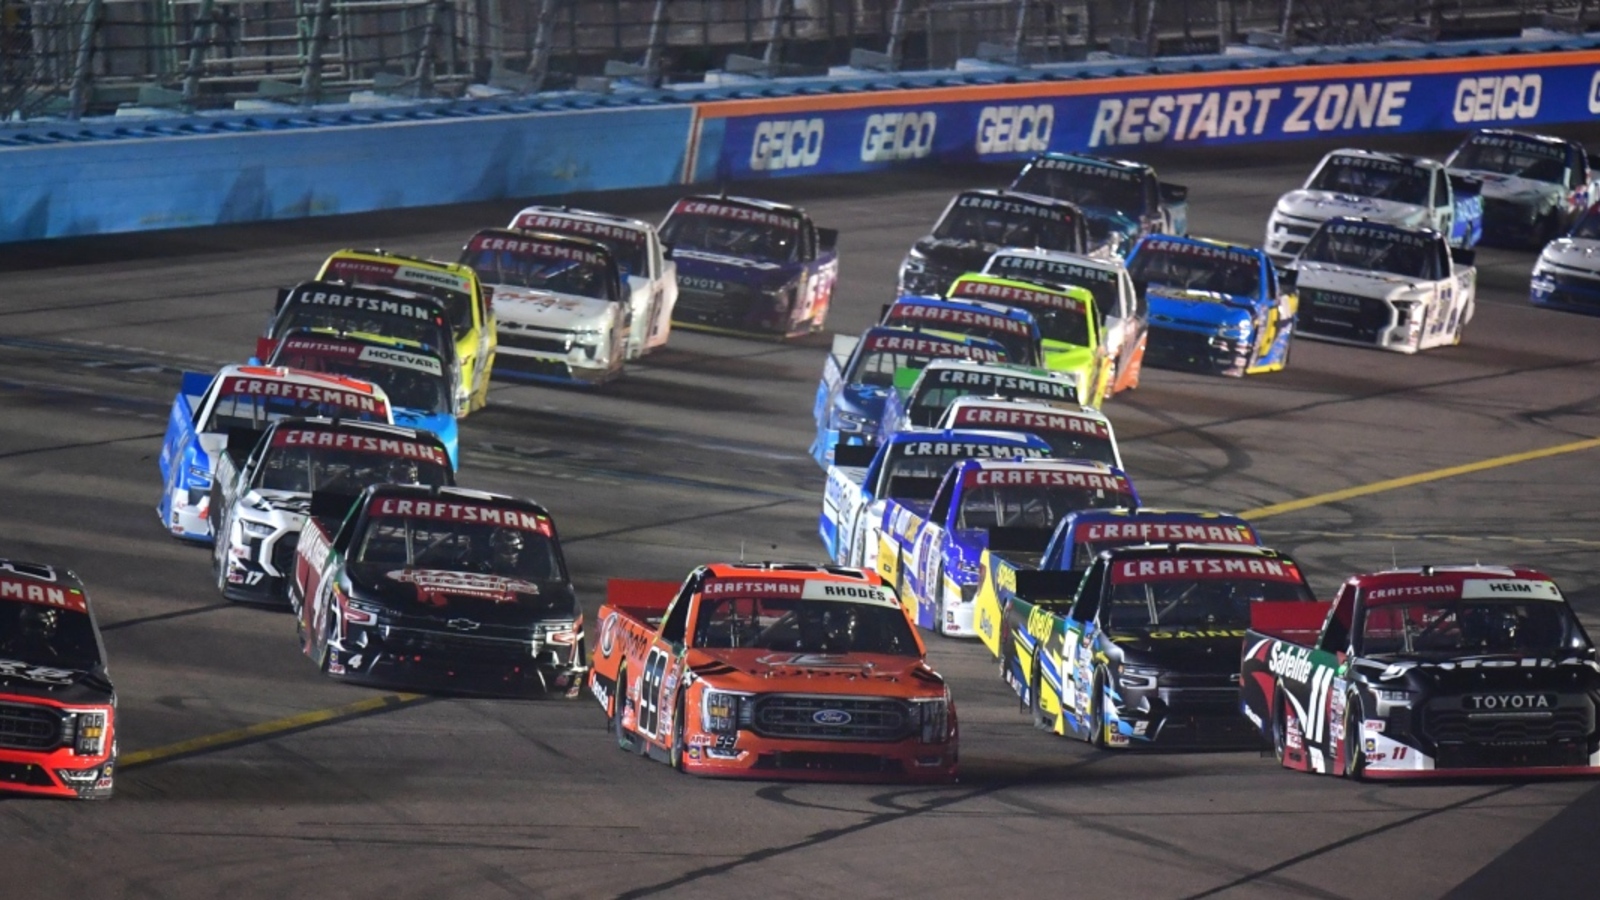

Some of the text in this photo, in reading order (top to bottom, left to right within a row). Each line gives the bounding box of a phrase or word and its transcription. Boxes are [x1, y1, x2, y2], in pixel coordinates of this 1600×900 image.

[1453, 74, 1542, 124] GEICO
[1088, 80, 1412, 149] RESTART ZONE
[861, 111, 938, 163] GEICO
[975, 105, 1055, 154] GEICO
[750, 118, 825, 171] GEICO
[684, 202, 792, 228] CRAFTSMAN
[959, 196, 1062, 221] CRAFTSMAN
[524, 214, 638, 242] CRAFTSMAN
[480, 237, 601, 263] CRAFTSMAN
[404, 270, 460, 288] ENFINGER
[1000, 256, 1112, 283] CRAFTSMAN
[300, 291, 430, 320] CRAFTSMAN
[964, 281, 1077, 310] CRAFTSMAN
[901, 304, 1017, 333] CRAFTSMAN
[367, 349, 435, 369] HOCEVAR
[875, 335, 1000, 363] CRAFTSMAN
[233, 378, 376, 411] CRAFTSMAN
[938, 370, 1066, 399] CRAFTSMAN
[965, 408, 1099, 435] CRAFTSMAN
[286, 430, 436, 461] CRAFTSMAN
[975, 470, 1119, 491] CRAFTSMAN
[382, 498, 538, 532] CRAFTSMAN
[1088, 523, 1242, 543] CRAFTSMAN
[245, 571, 264, 586] 17
[1123, 557, 1285, 578] CRAFTSMAN
[704, 583, 887, 601] CRAFTSMAN RHODES
[1368, 581, 1533, 600] CRAFTSMAN HEIM
[347, 653, 363, 669] 4
[1268, 640, 1314, 685] Safelite
[1305, 664, 1335, 744] 11
[1472, 694, 1549, 709] TOYOTA
[820, 711, 843, 724] Ford
[1132, 720, 1150, 736] 2
[715, 735, 738, 749] 99
[1392, 746, 1409, 760] 11
